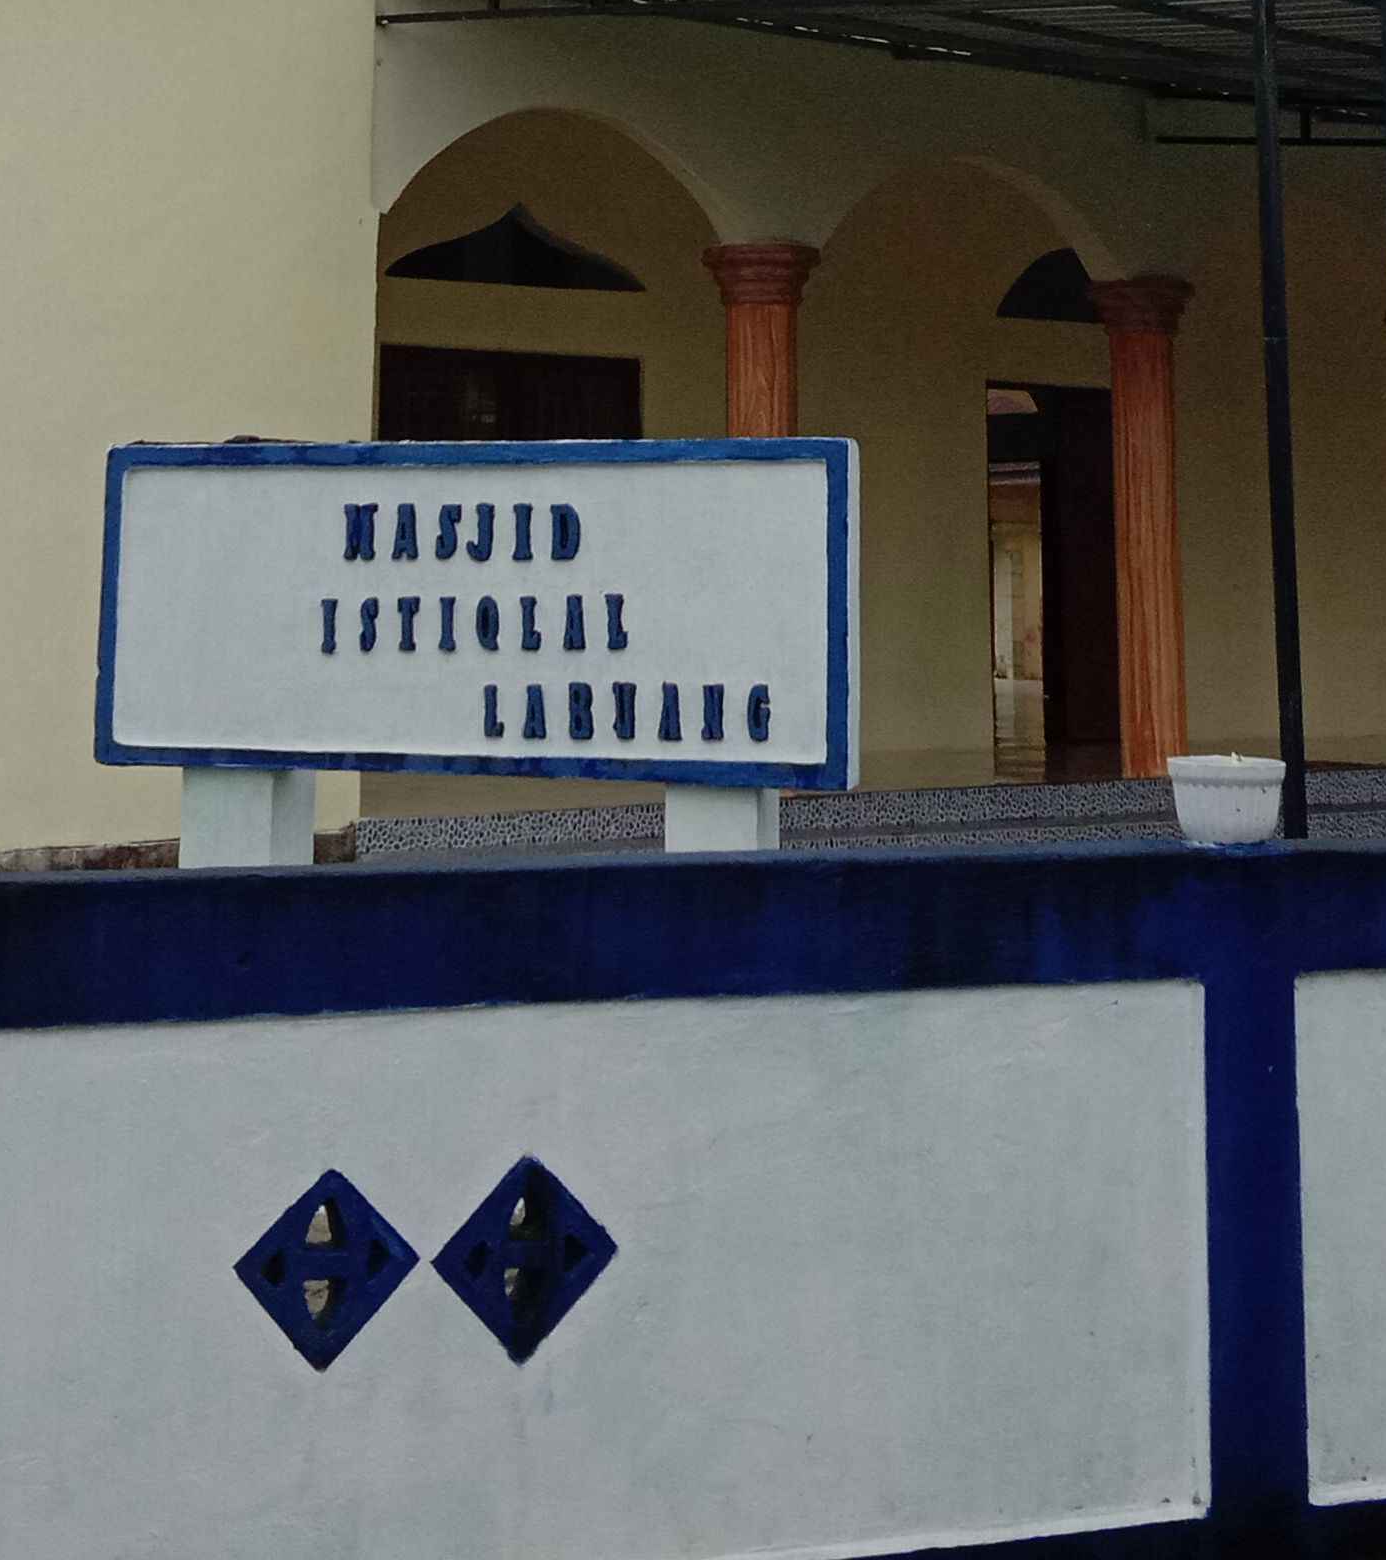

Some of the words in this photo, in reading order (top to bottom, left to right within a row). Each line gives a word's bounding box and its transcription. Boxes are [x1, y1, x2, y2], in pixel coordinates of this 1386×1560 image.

[343, 502, 582, 563] MASJID
[320, 593, 629, 655] ISTIQLAL
[483, 681, 772, 743] LABUANG
